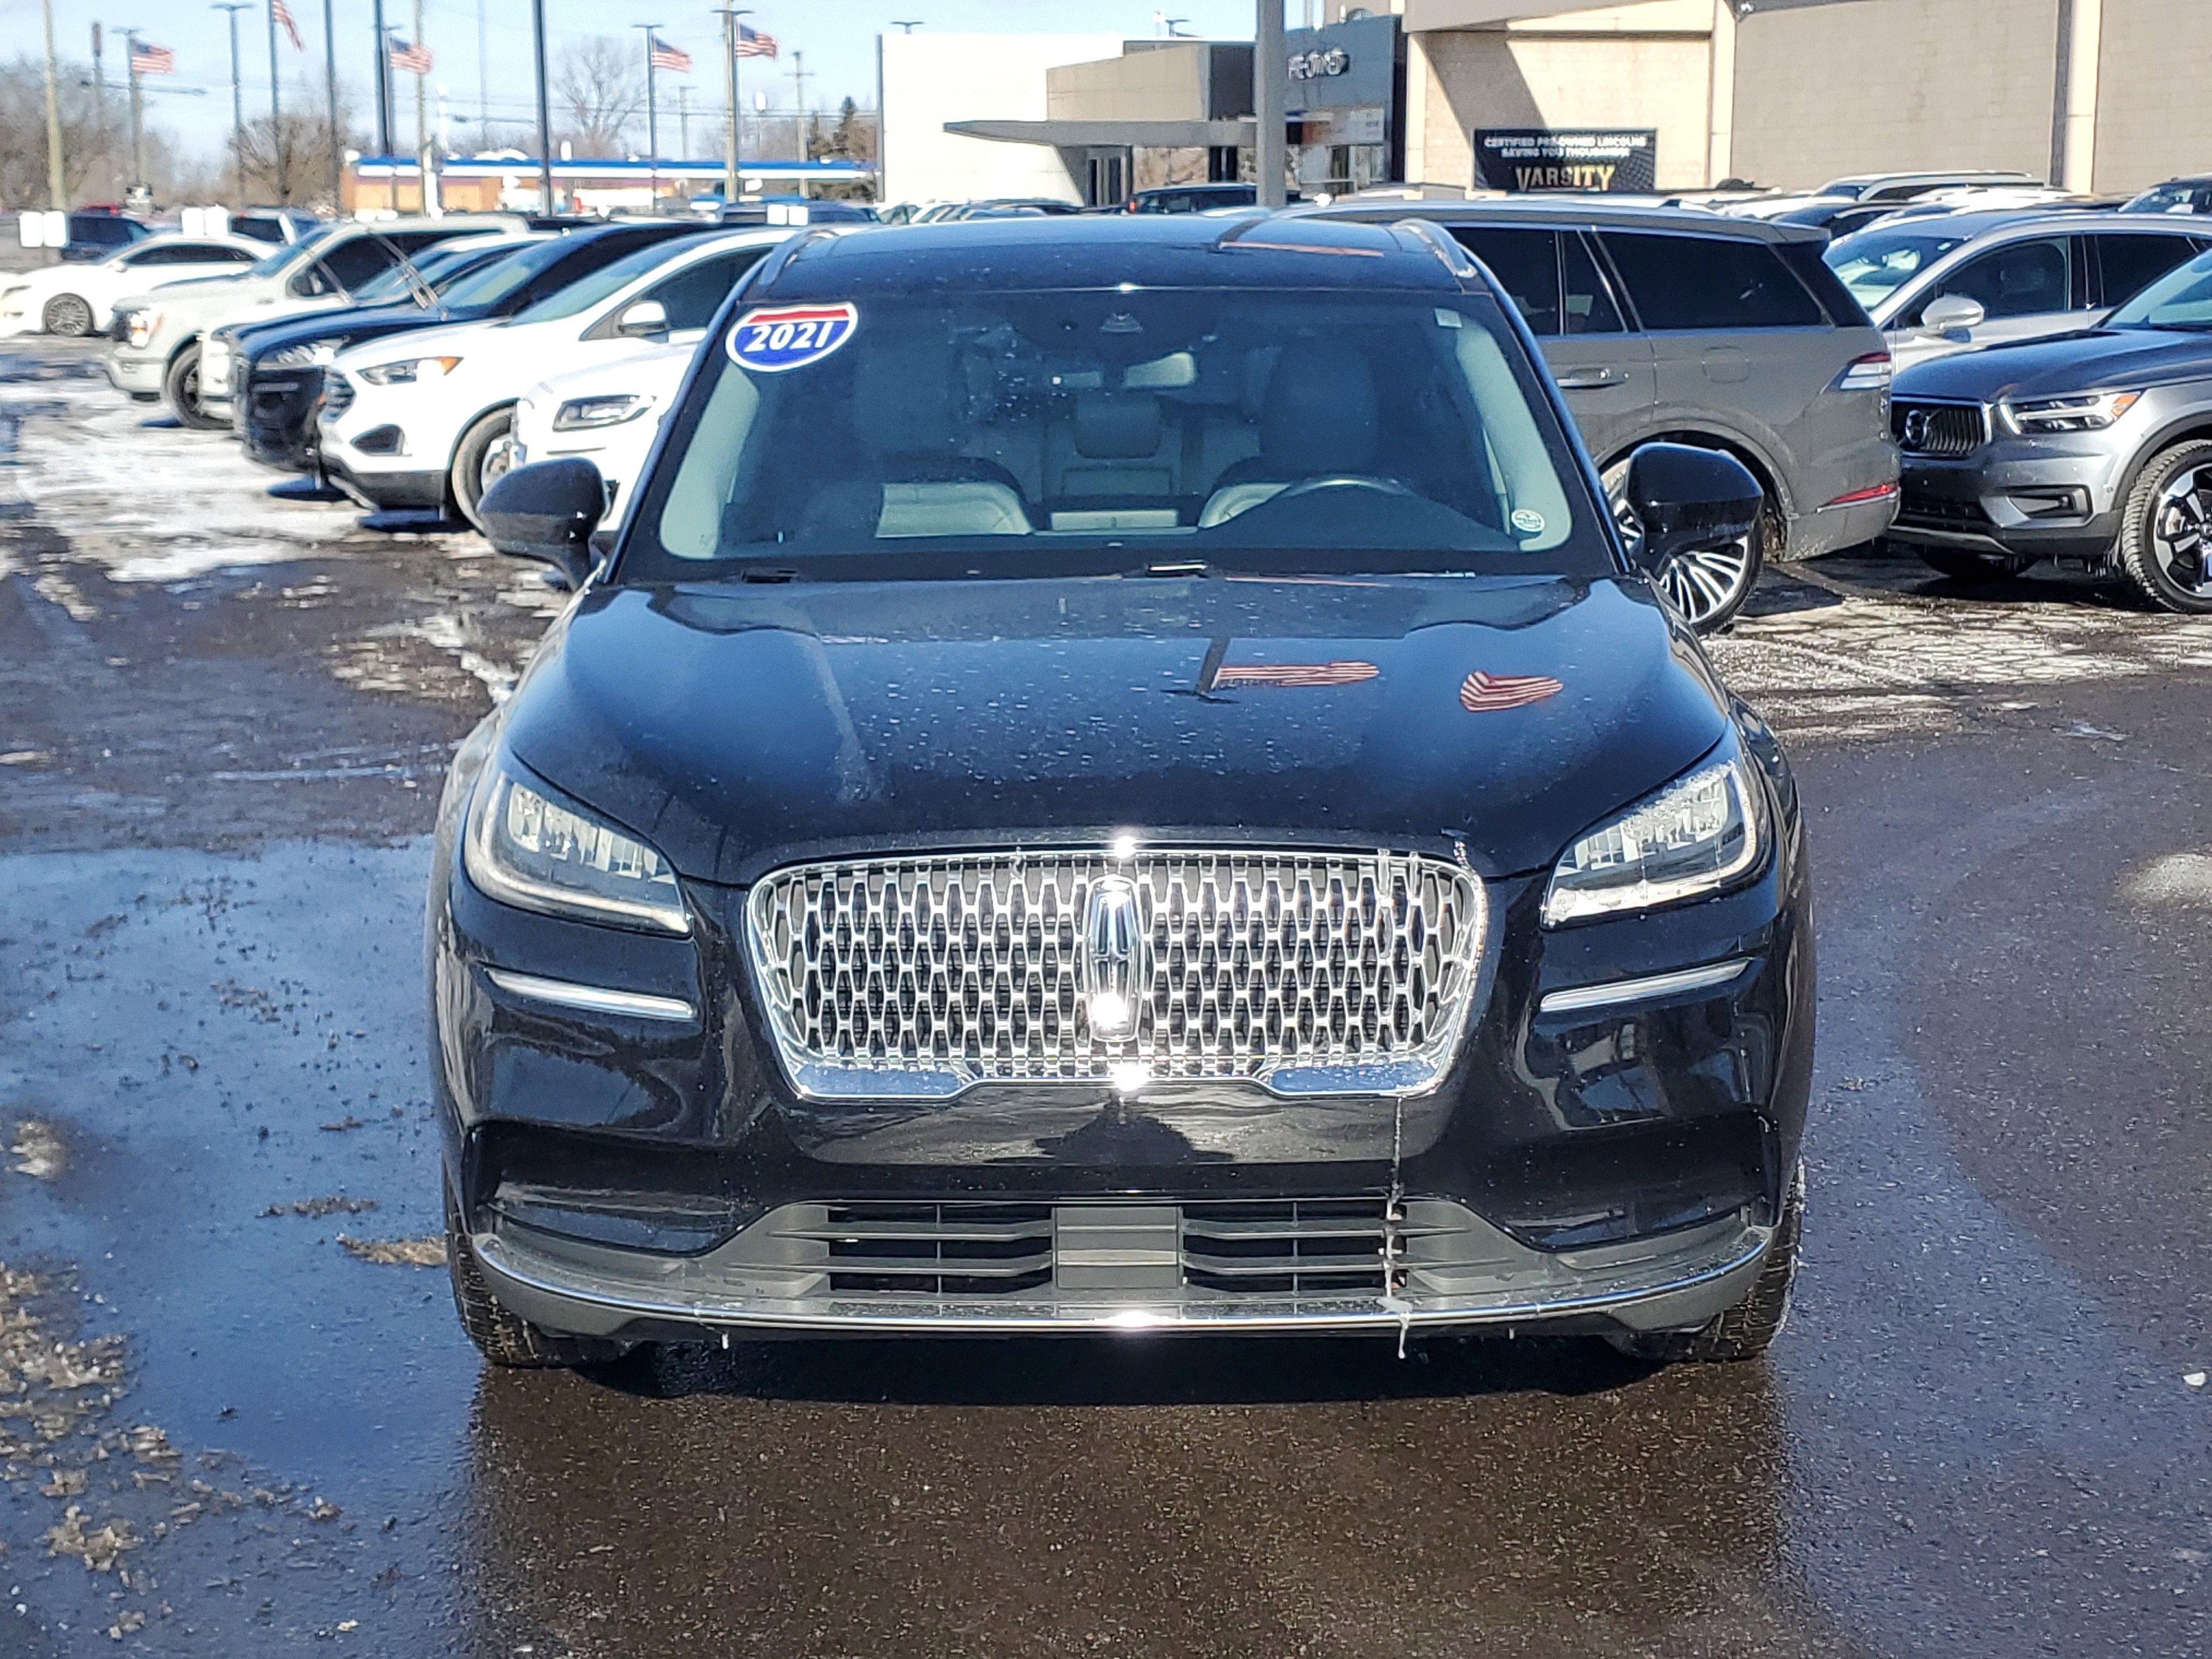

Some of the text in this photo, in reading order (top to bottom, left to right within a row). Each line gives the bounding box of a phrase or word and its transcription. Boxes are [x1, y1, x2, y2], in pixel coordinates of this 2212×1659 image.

[1483, 136, 1535, 148] CERTIFIED
[1542, 148, 1564, 158] YOU
[1515, 166, 1615, 191] VARSITY
[743, 321, 834, 352] 2021
